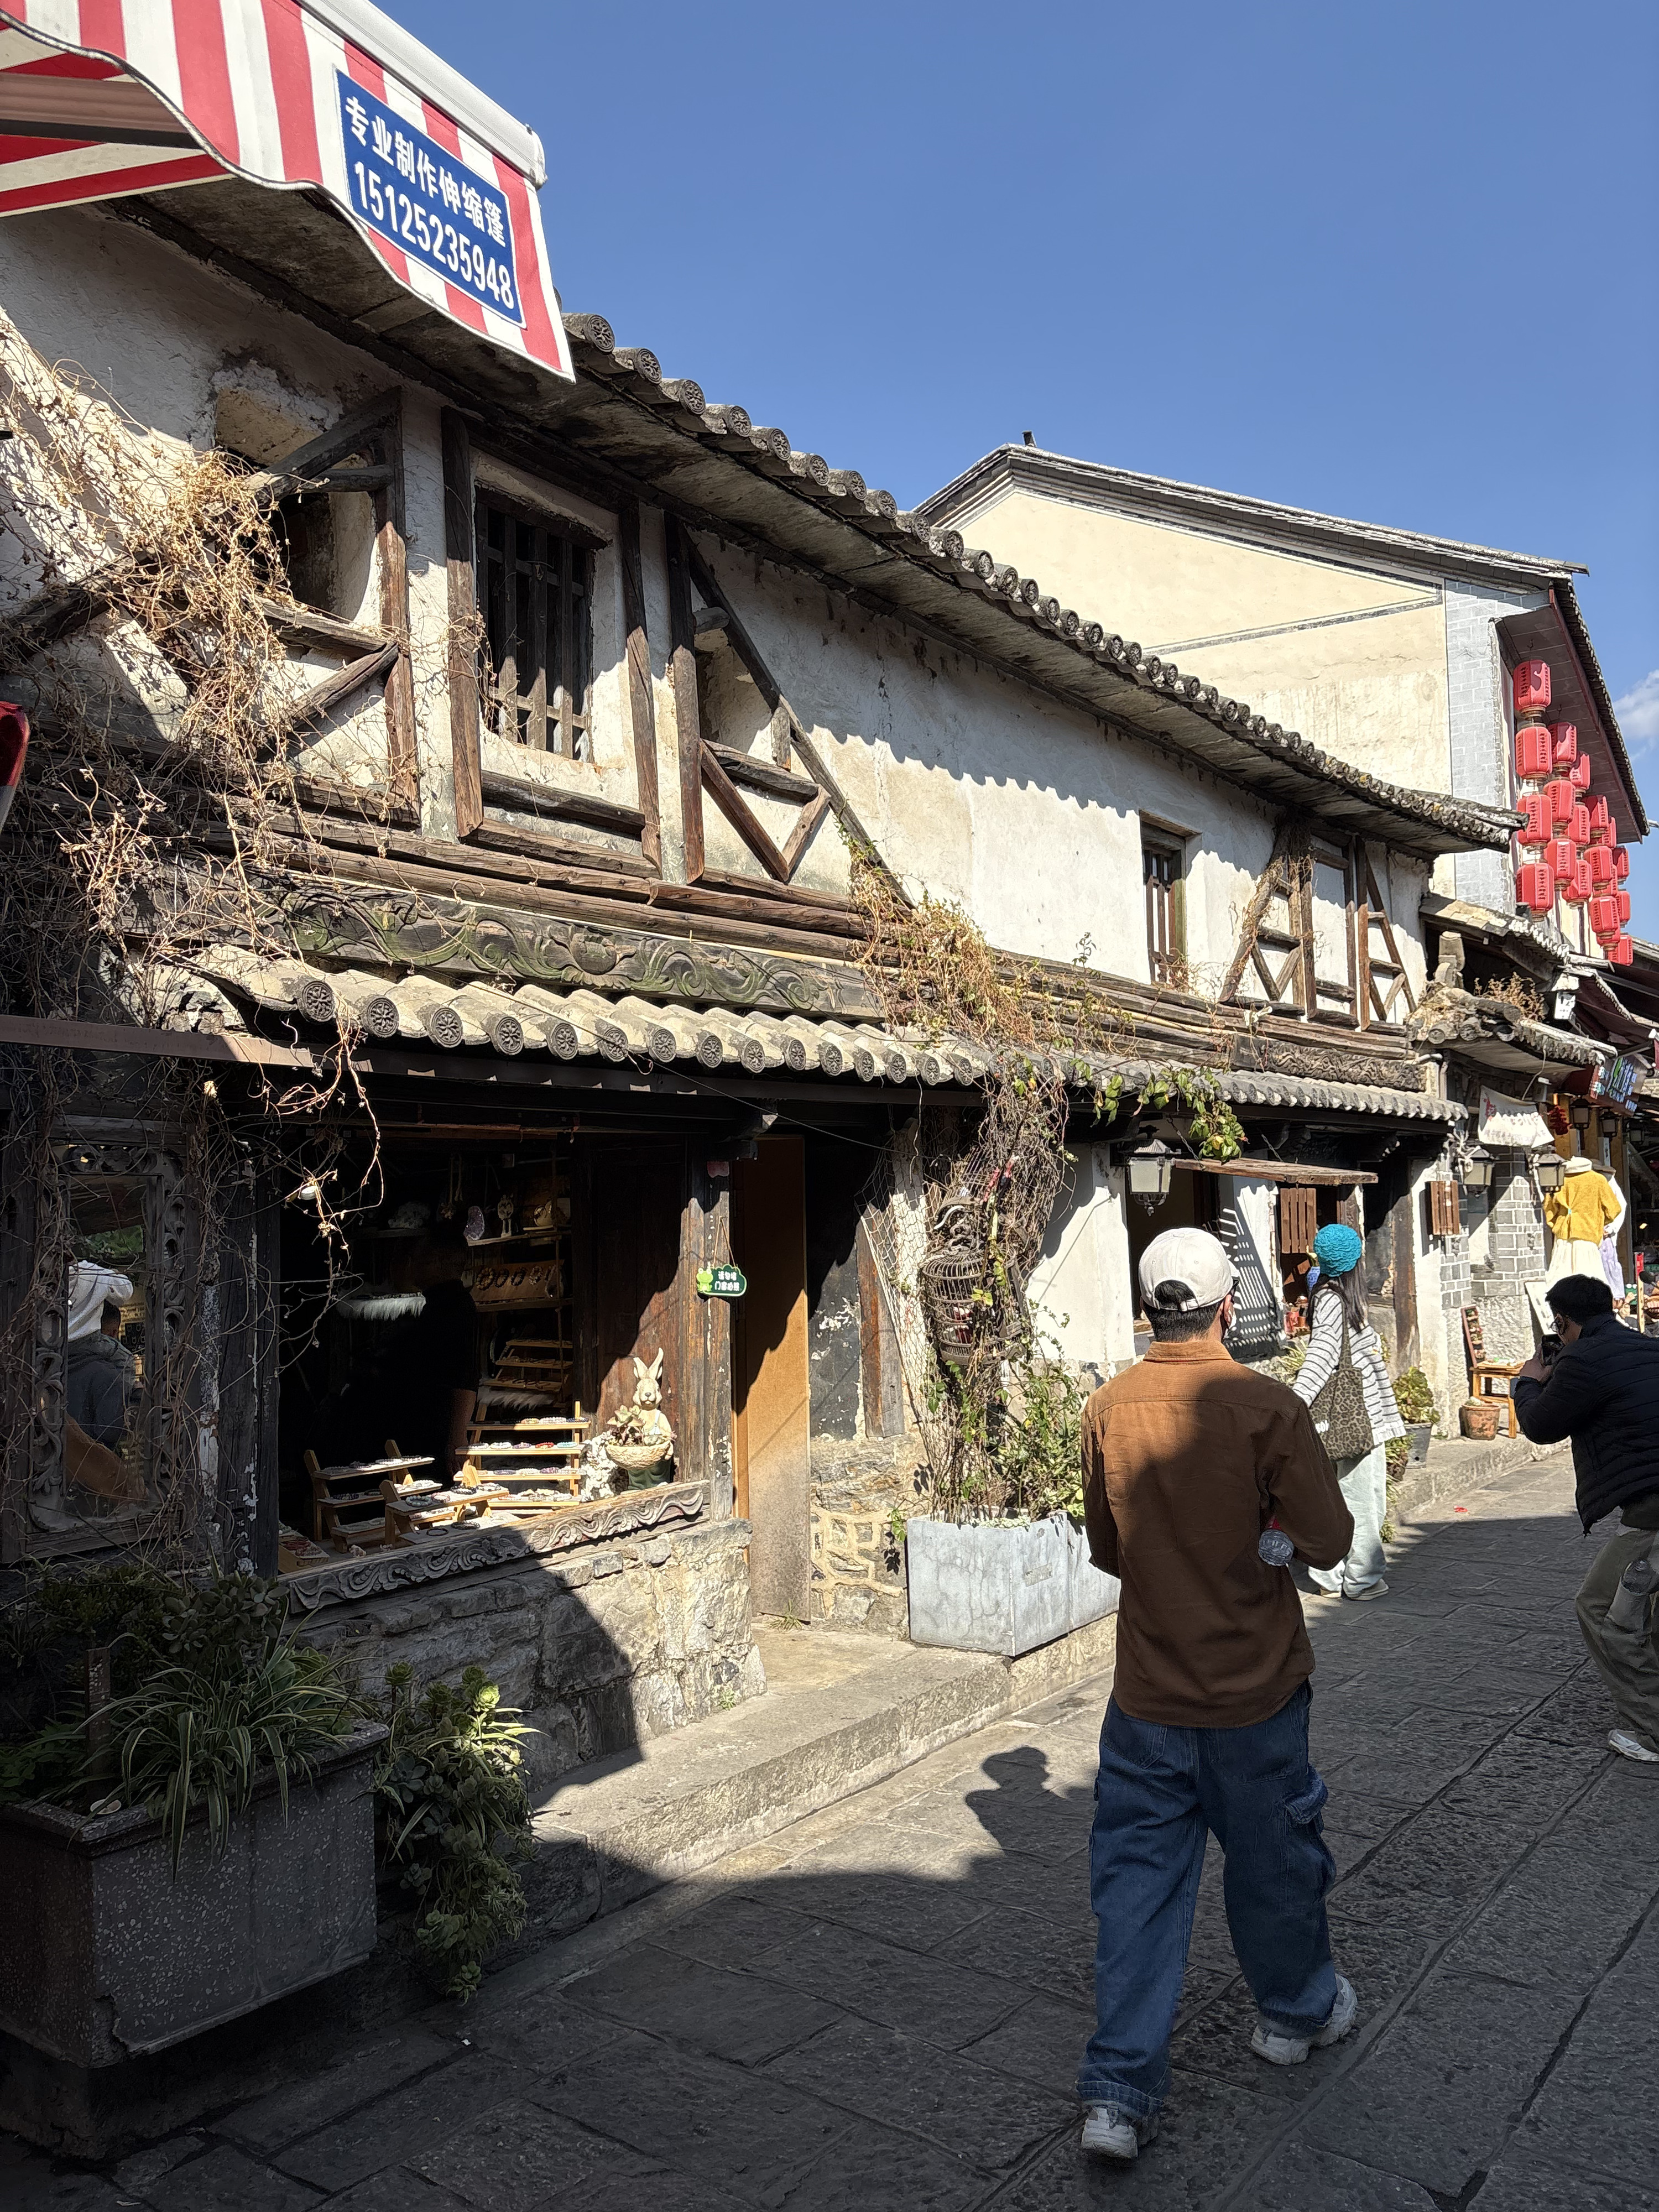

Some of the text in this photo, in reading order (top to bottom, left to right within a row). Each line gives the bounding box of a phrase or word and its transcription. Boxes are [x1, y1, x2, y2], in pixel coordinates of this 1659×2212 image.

[346, 96, 505, 247] 专业制作伸缩篷
[355, 162, 514, 309] 15125235948
